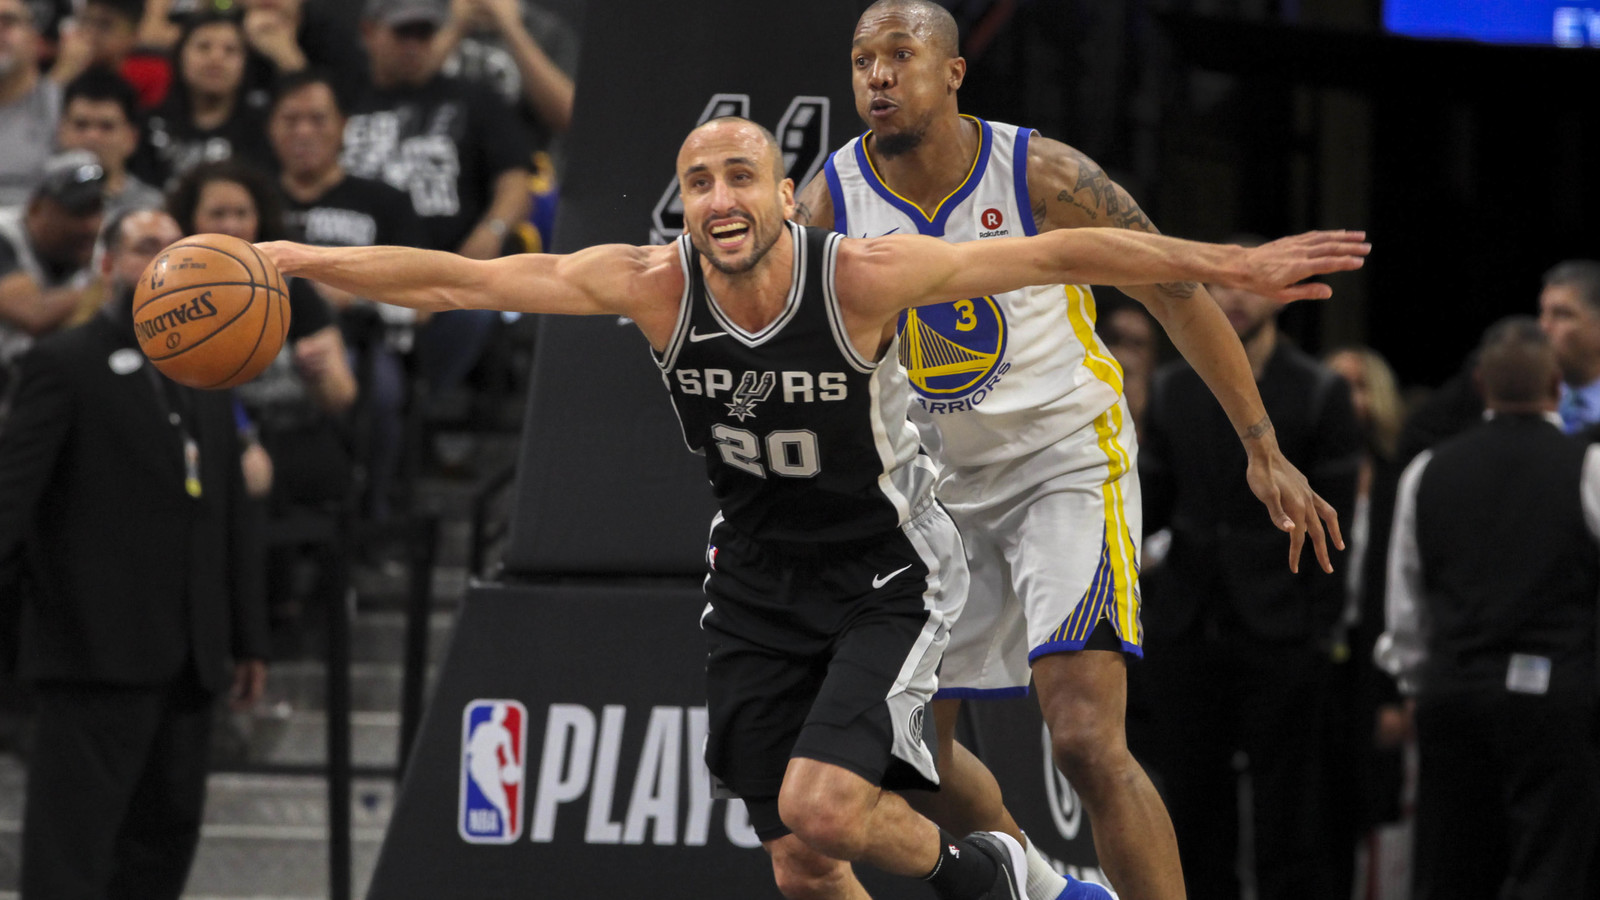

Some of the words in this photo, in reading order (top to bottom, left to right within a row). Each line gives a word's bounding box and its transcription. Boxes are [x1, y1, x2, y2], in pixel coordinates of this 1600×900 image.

[979, 229, 1009, 239] Rakuten
[986, 212, 999, 227] R
[952, 299, 978, 332] 3
[675, 367, 848, 423] SPURS
[711, 422, 822, 480] 20
[469, 808, 499, 833] NBA
